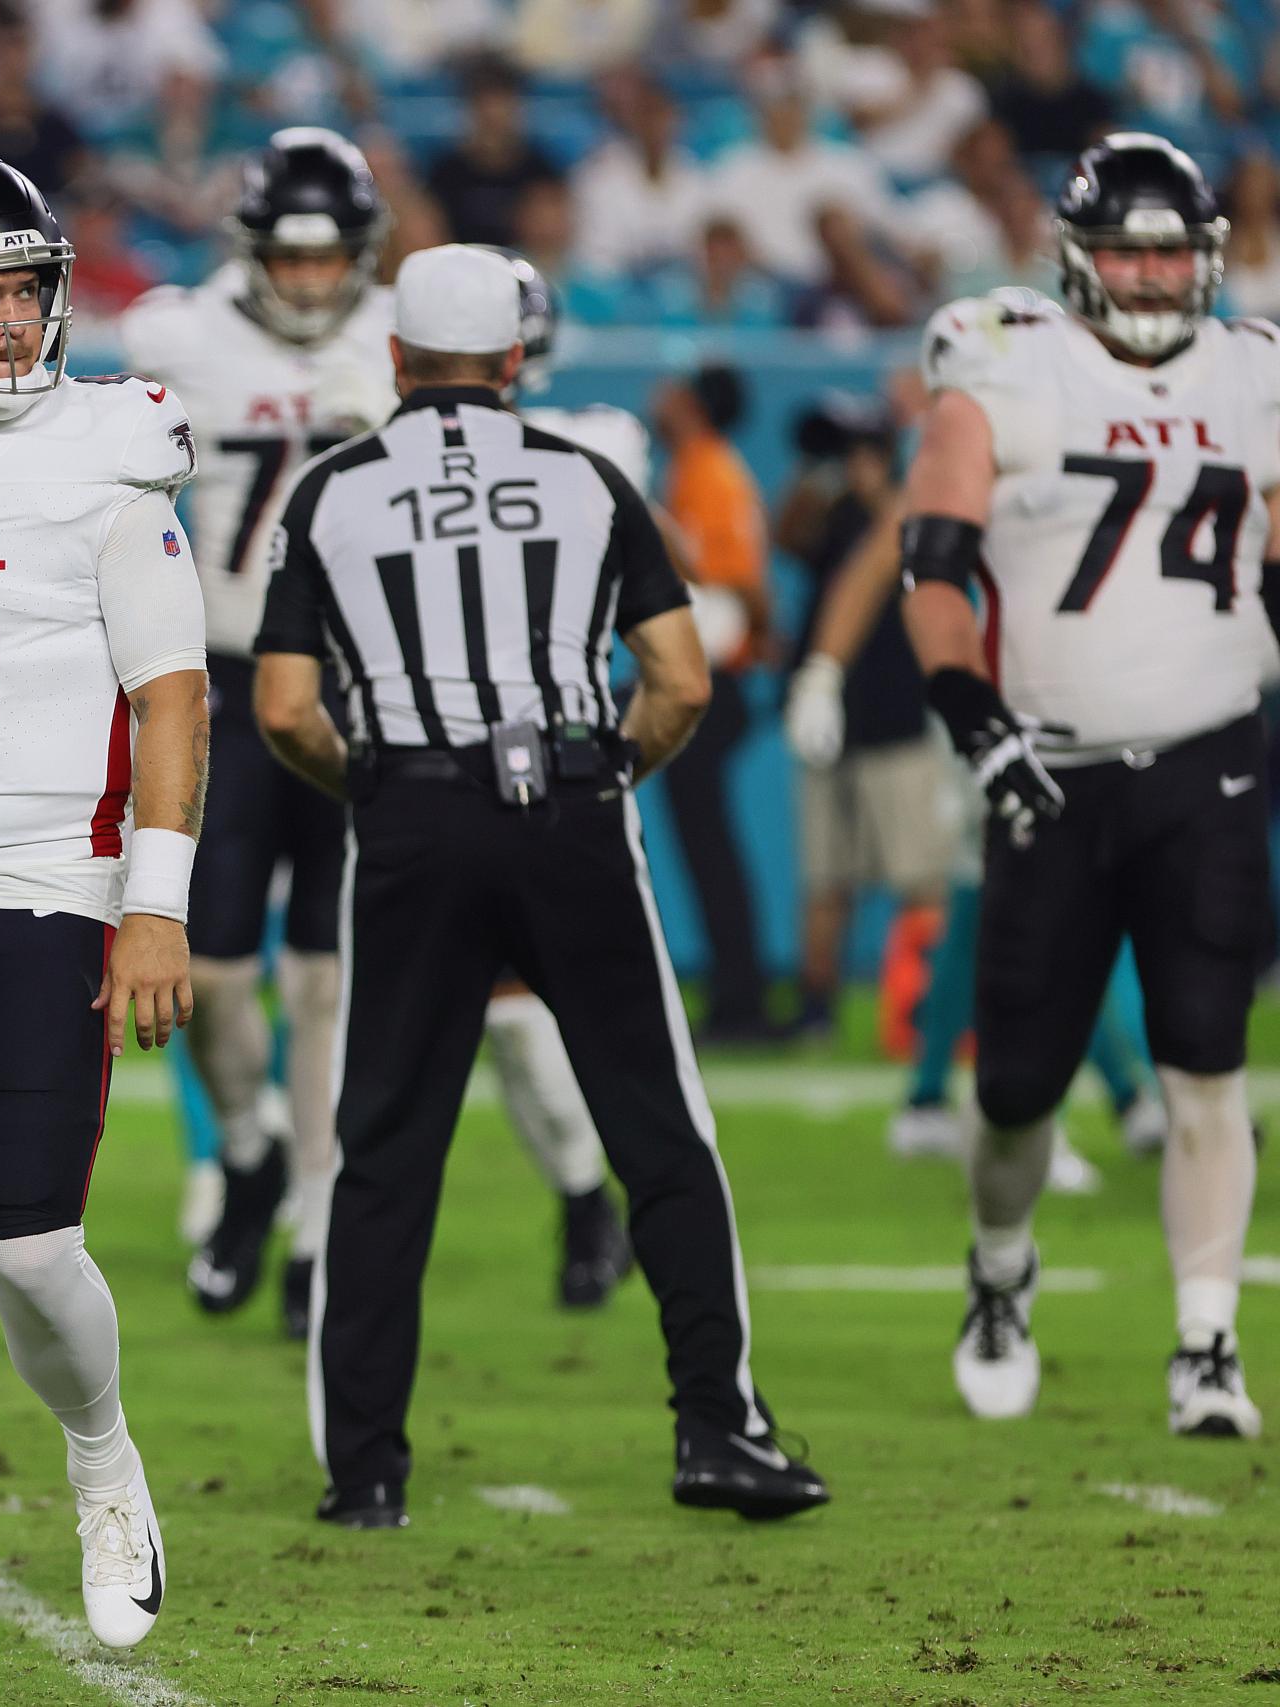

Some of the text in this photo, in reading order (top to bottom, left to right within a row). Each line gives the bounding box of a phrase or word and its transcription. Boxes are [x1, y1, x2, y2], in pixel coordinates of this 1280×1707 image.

[3, 233, 36, 247] ATL
[245, 393, 312, 424] AT
[1104, 416, 1224, 453] ATL
[442, 453, 478, 479] R
[389, 479, 542, 541] 126
[1057, 451, 1250, 614] 74
